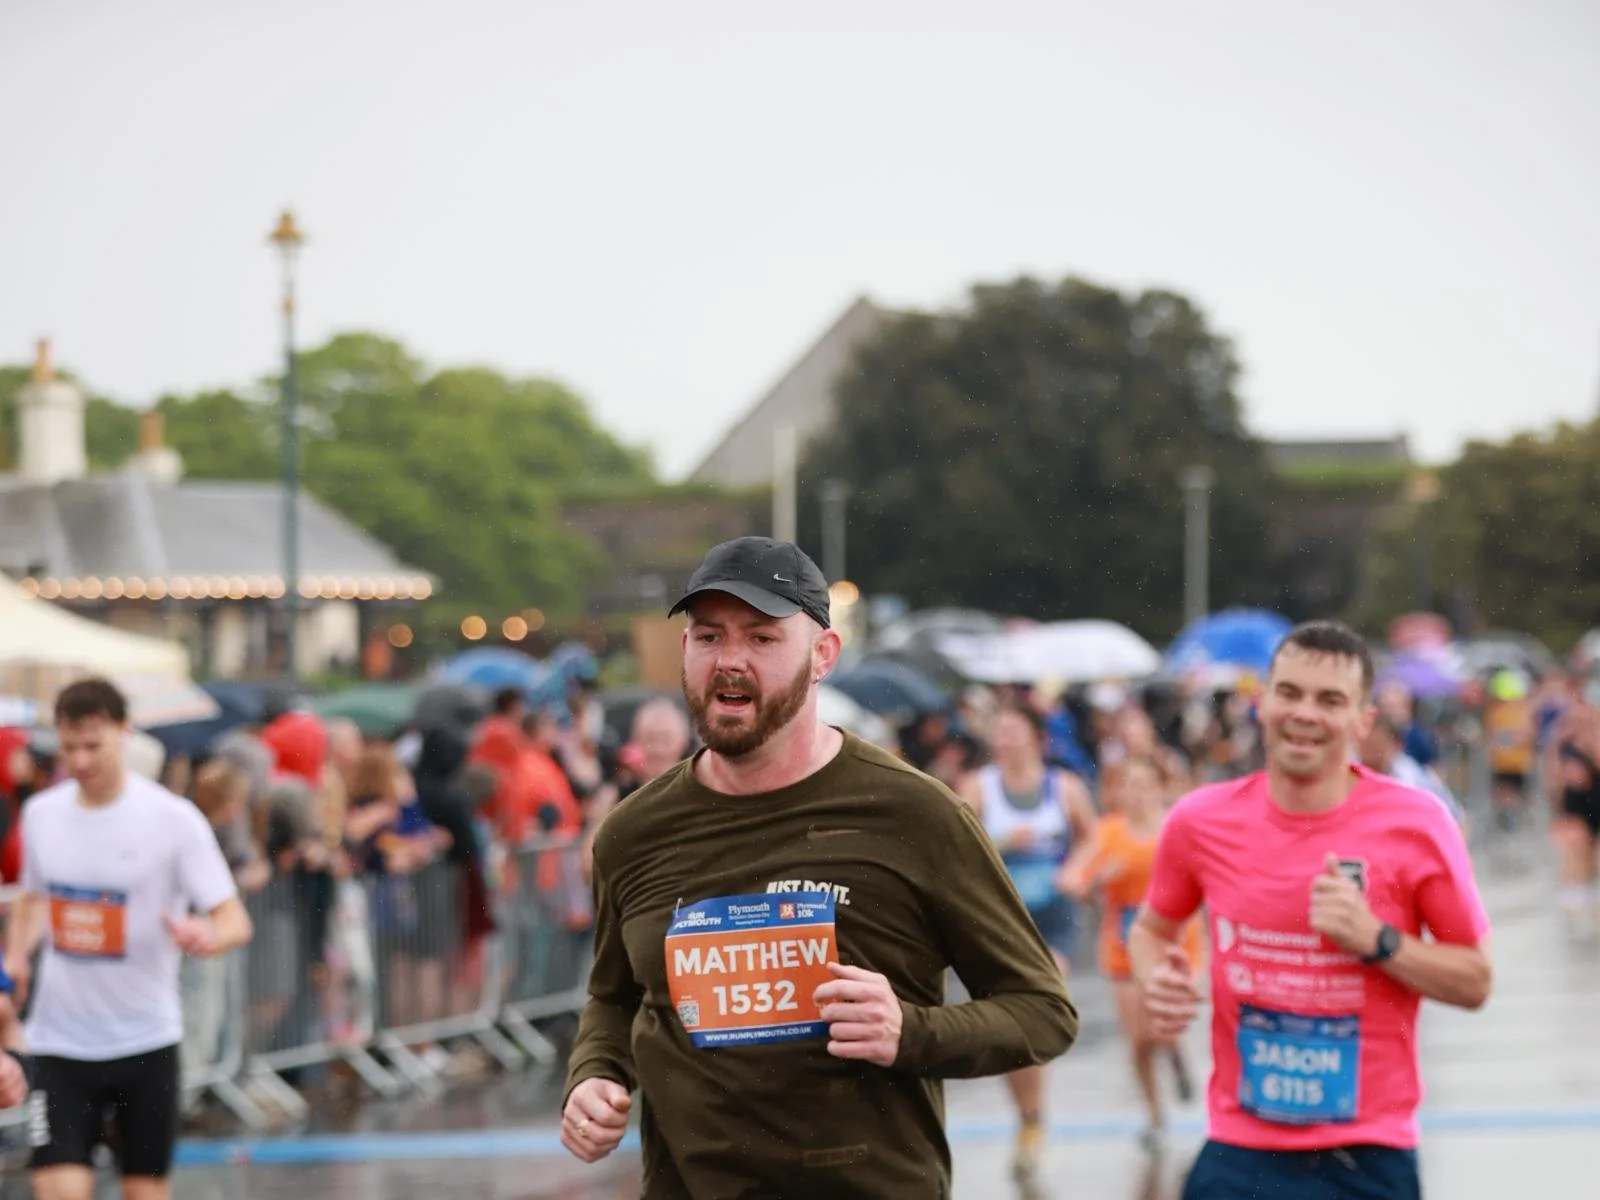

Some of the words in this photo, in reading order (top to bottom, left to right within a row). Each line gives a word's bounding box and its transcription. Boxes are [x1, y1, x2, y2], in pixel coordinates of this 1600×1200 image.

[674, 917, 722, 930] PLYMOUTH
[728, 901, 770, 915] Plymouth
[674, 938, 829, 977] MATTHEW
[712, 979, 799, 1016] 1532
[1251, 1040, 1340, 1074] JASON
[1262, 1073, 1324, 1105] 6115
